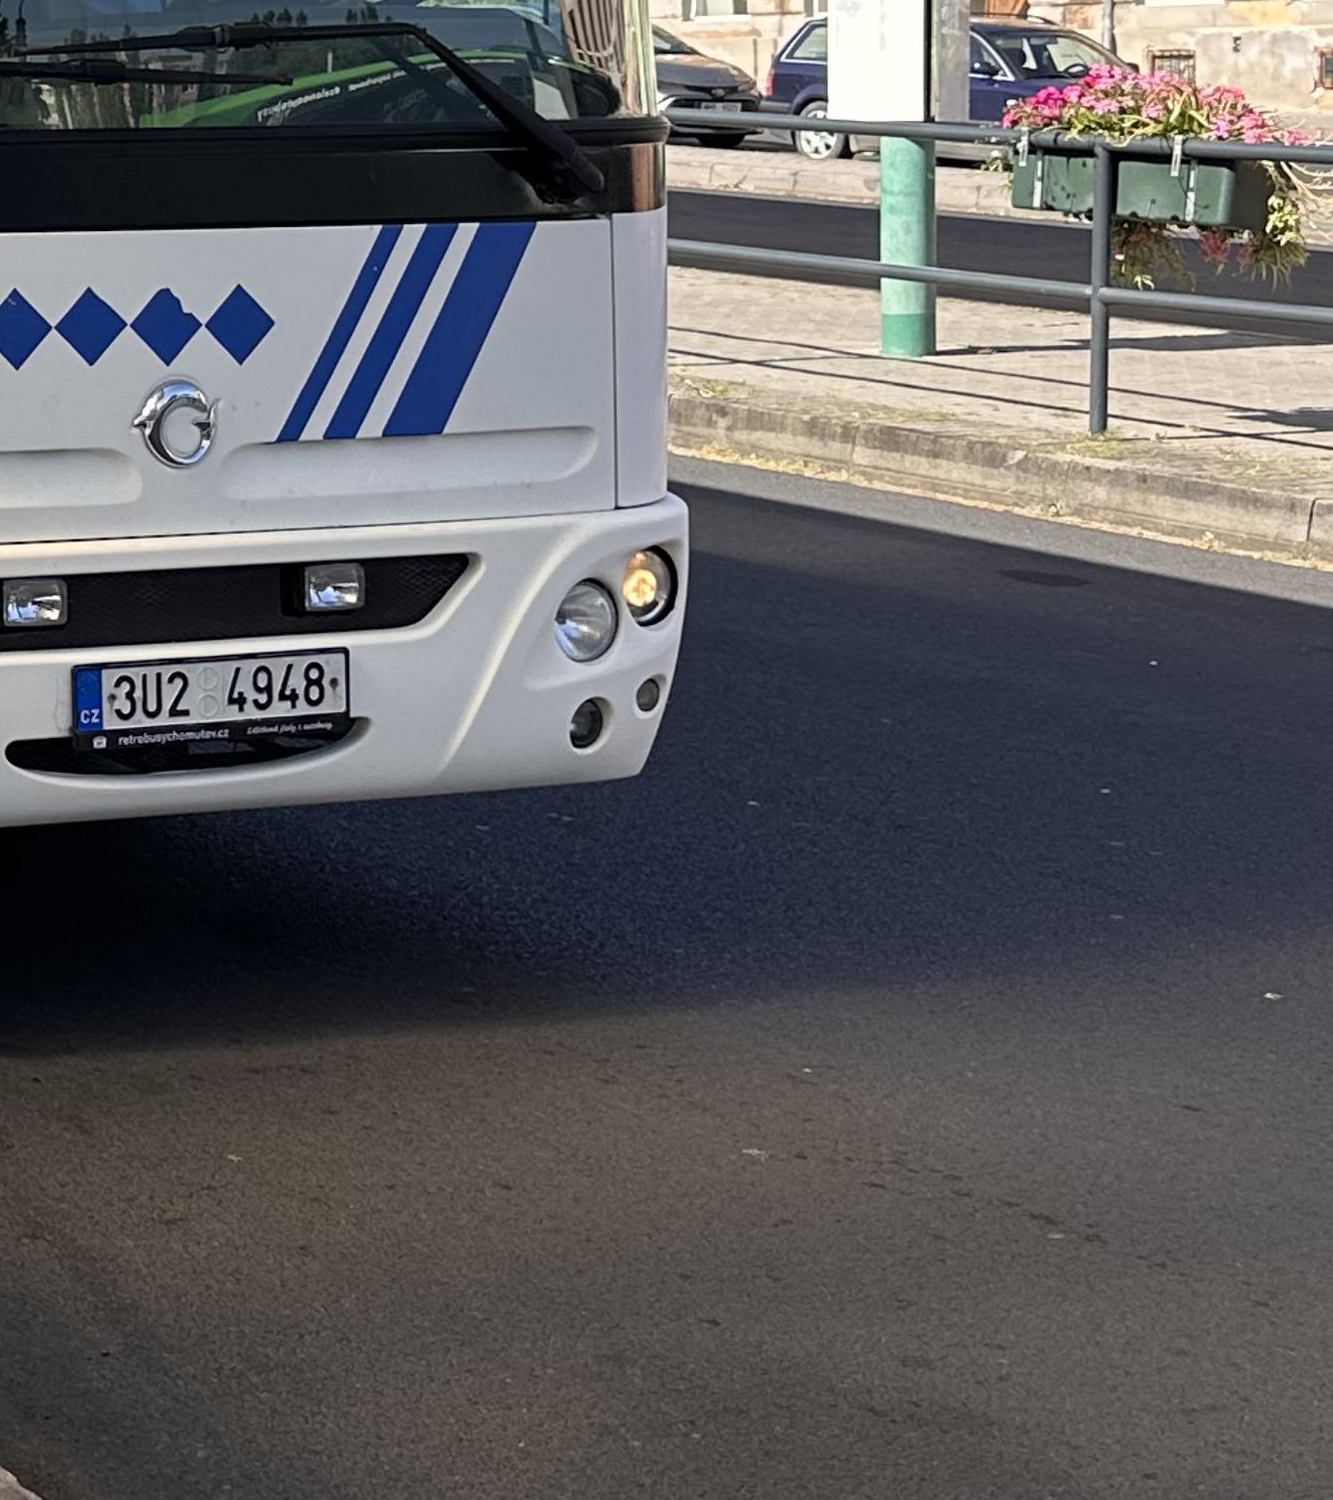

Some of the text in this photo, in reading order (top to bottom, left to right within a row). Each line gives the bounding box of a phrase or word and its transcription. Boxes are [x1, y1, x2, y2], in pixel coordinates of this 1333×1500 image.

[113, 661, 325, 721] 3U2 4948
[80, 708, 101, 725] CZ
